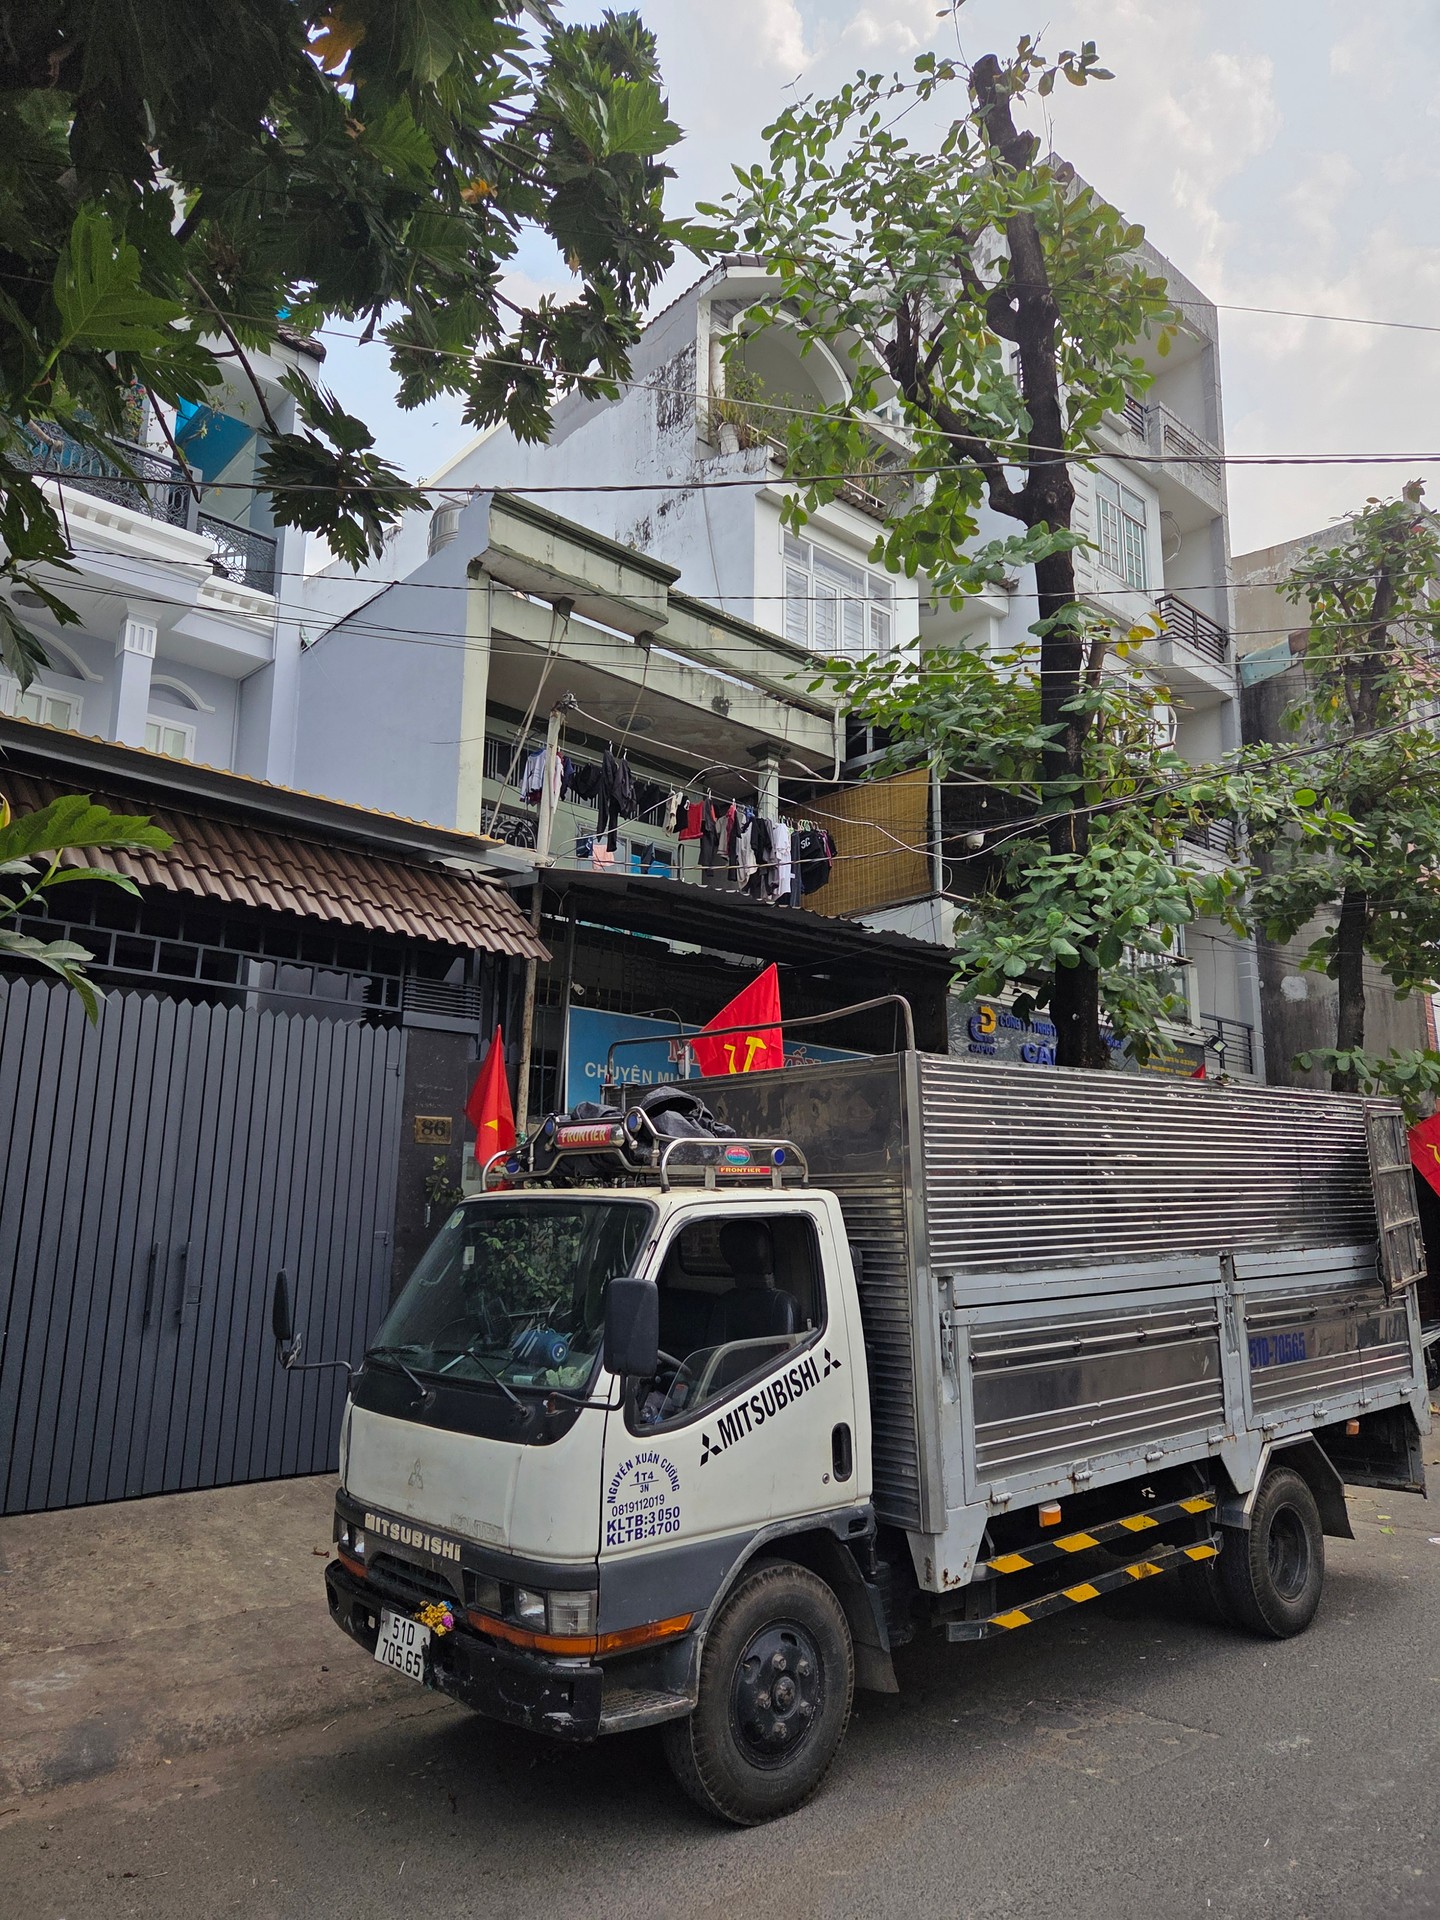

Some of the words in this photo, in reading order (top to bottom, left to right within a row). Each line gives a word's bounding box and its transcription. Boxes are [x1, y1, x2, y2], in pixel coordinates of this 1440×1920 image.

[421, 1119, 446, 1137] 86
[560, 1129, 606, 1143] FRONTIER
[1248, 1332, 1307, 1368] 51D-70565
[717, 1356, 820, 1449] MITSUBISHI
[635, 1450, 660, 1465] XUÂN
[634, 1471, 654, 1483] 1T4
[640, 1483, 649, 1493] 3N
[611, 1494, 665, 1517] 0819112019
[364, 1512, 462, 1562] MITSUBISHI
[606, 1519, 680, 1547] KLTB:4700
[392, 1617, 416, 1647] 51D
[382, 1638, 422, 1678] 705.65
